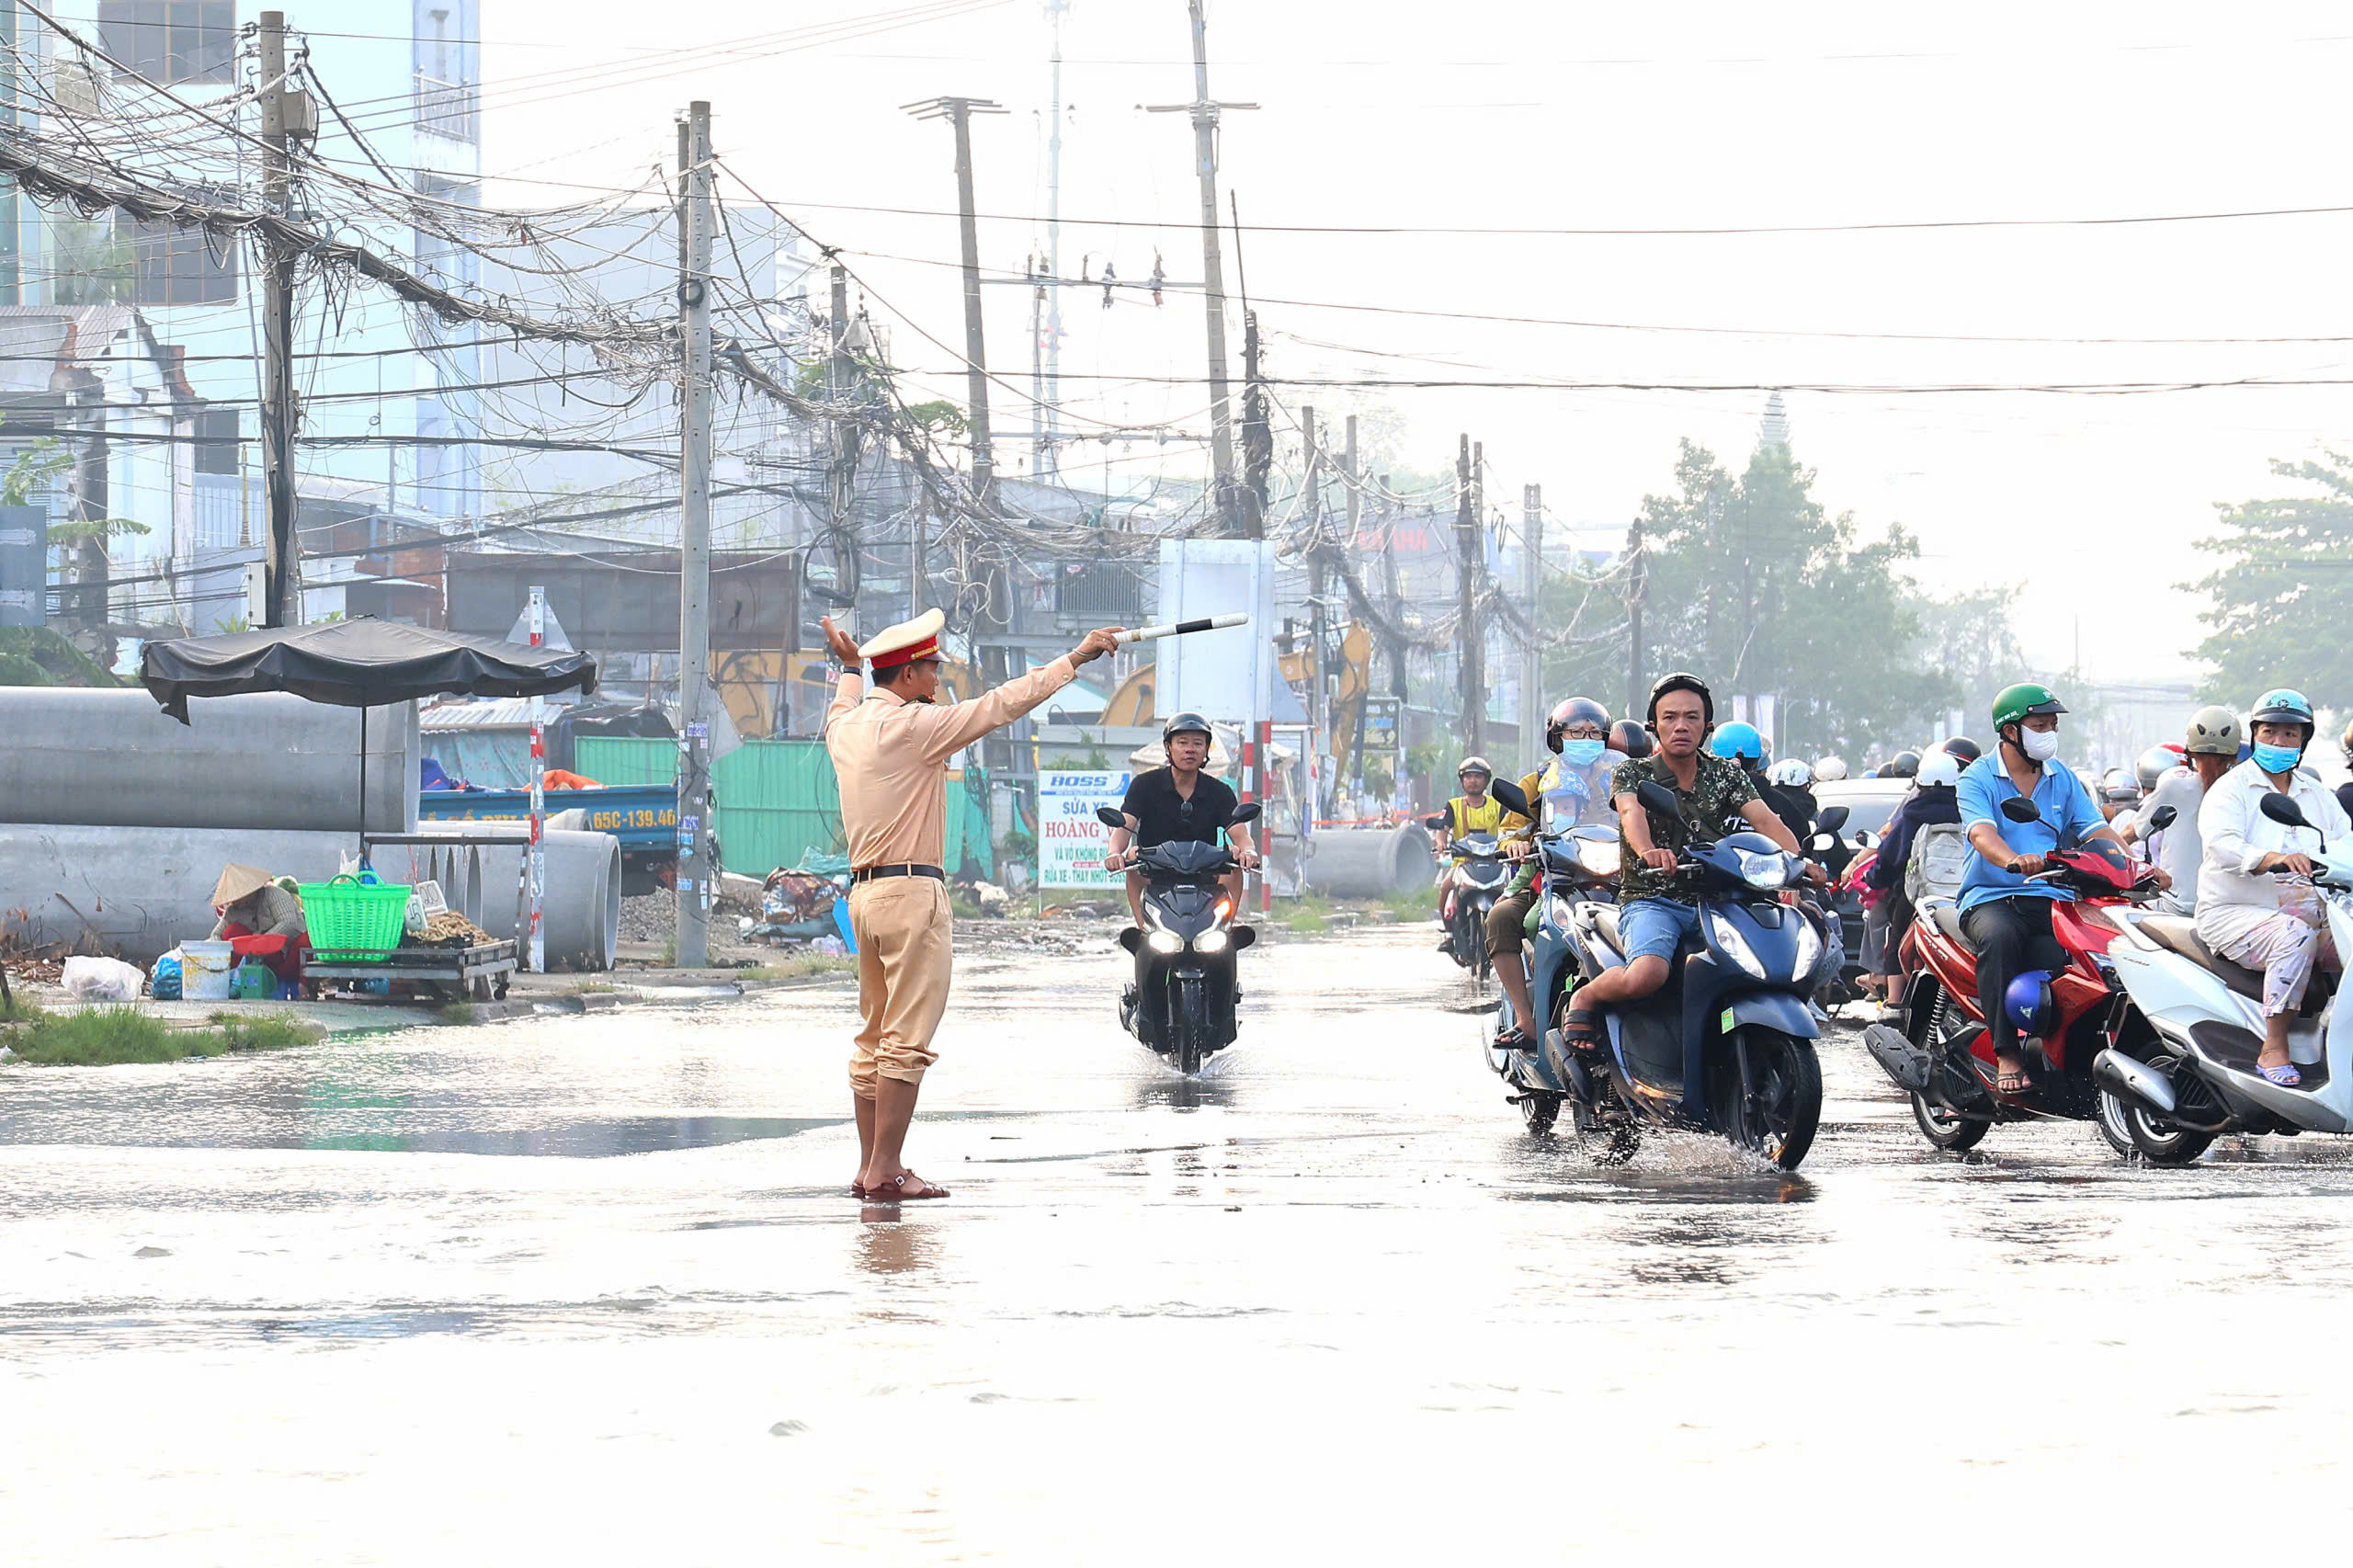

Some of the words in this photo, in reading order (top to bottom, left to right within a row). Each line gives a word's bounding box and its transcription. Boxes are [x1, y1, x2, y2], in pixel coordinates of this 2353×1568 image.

[1051, 777, 1108, 787] BOSS
[1063, 797, 1088, 815] SỬA
[1045, 817, 1099, 837] HOÀNG
